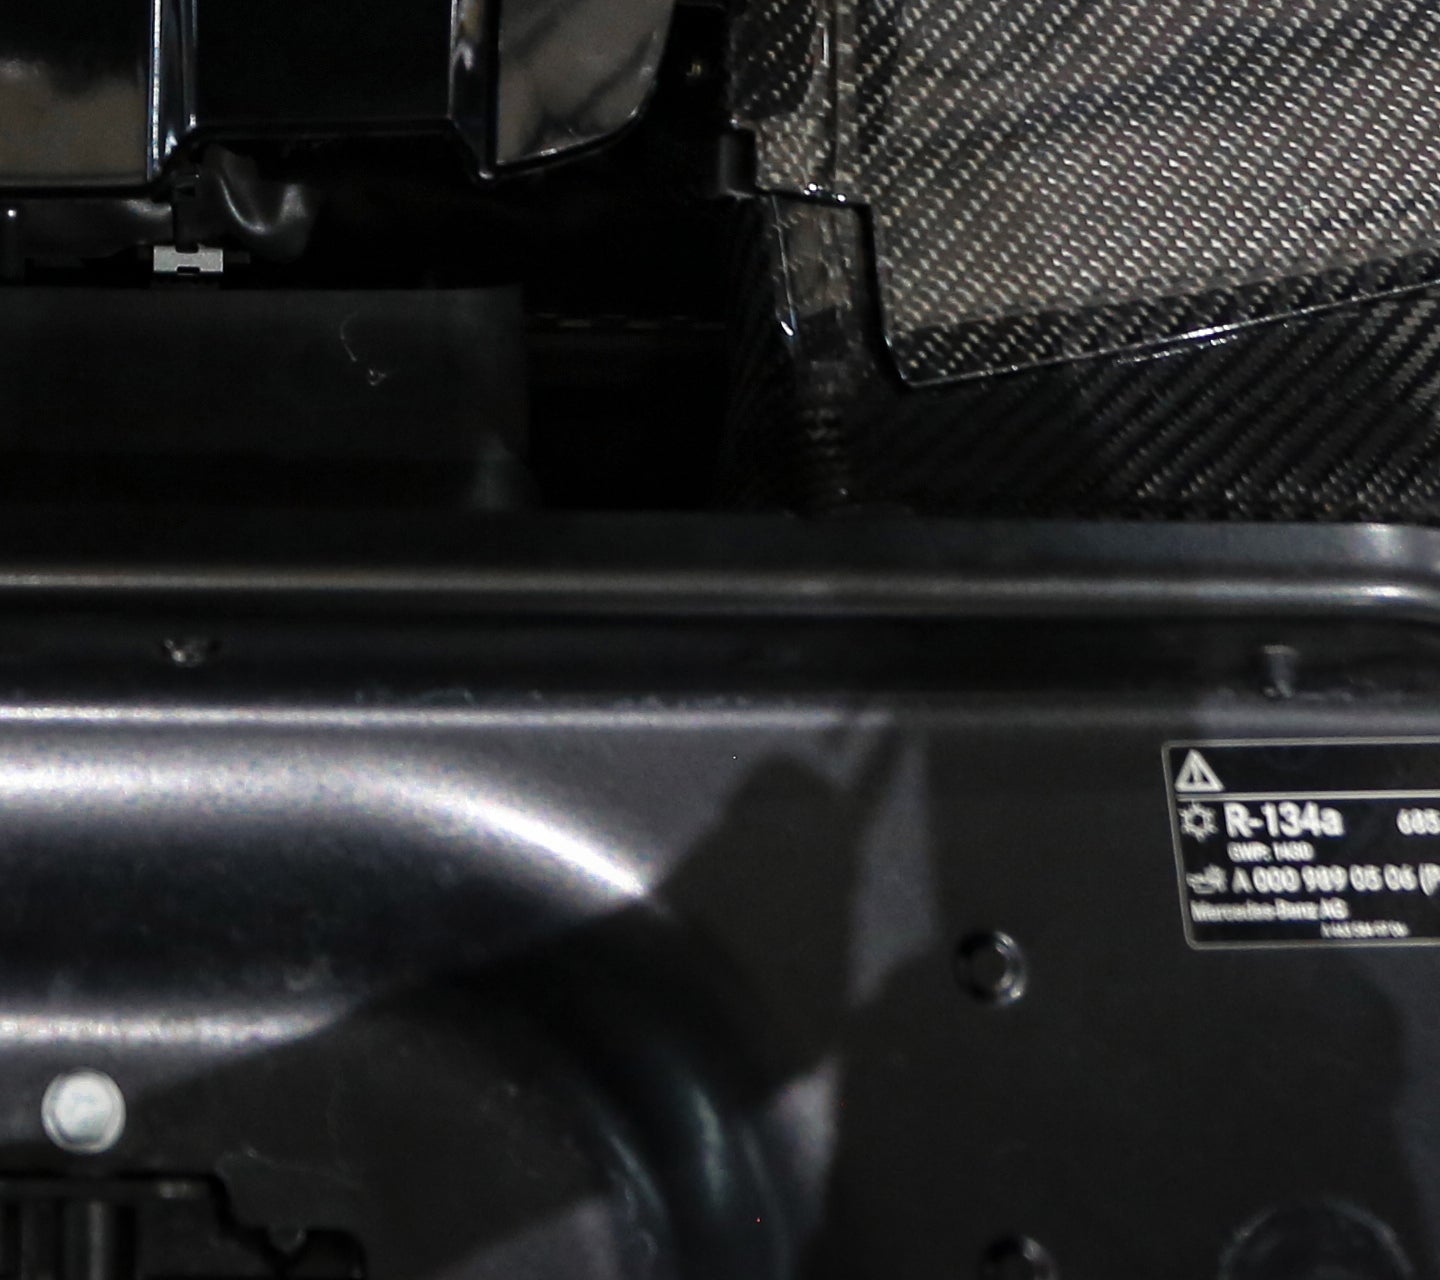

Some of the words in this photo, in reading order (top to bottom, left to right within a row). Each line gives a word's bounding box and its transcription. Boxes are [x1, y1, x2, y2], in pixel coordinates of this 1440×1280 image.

[1223, 801, 1345, 838] R-134a
[1232, 869, 1253, 893] A
[1252, 866, 1301, 893] 000
